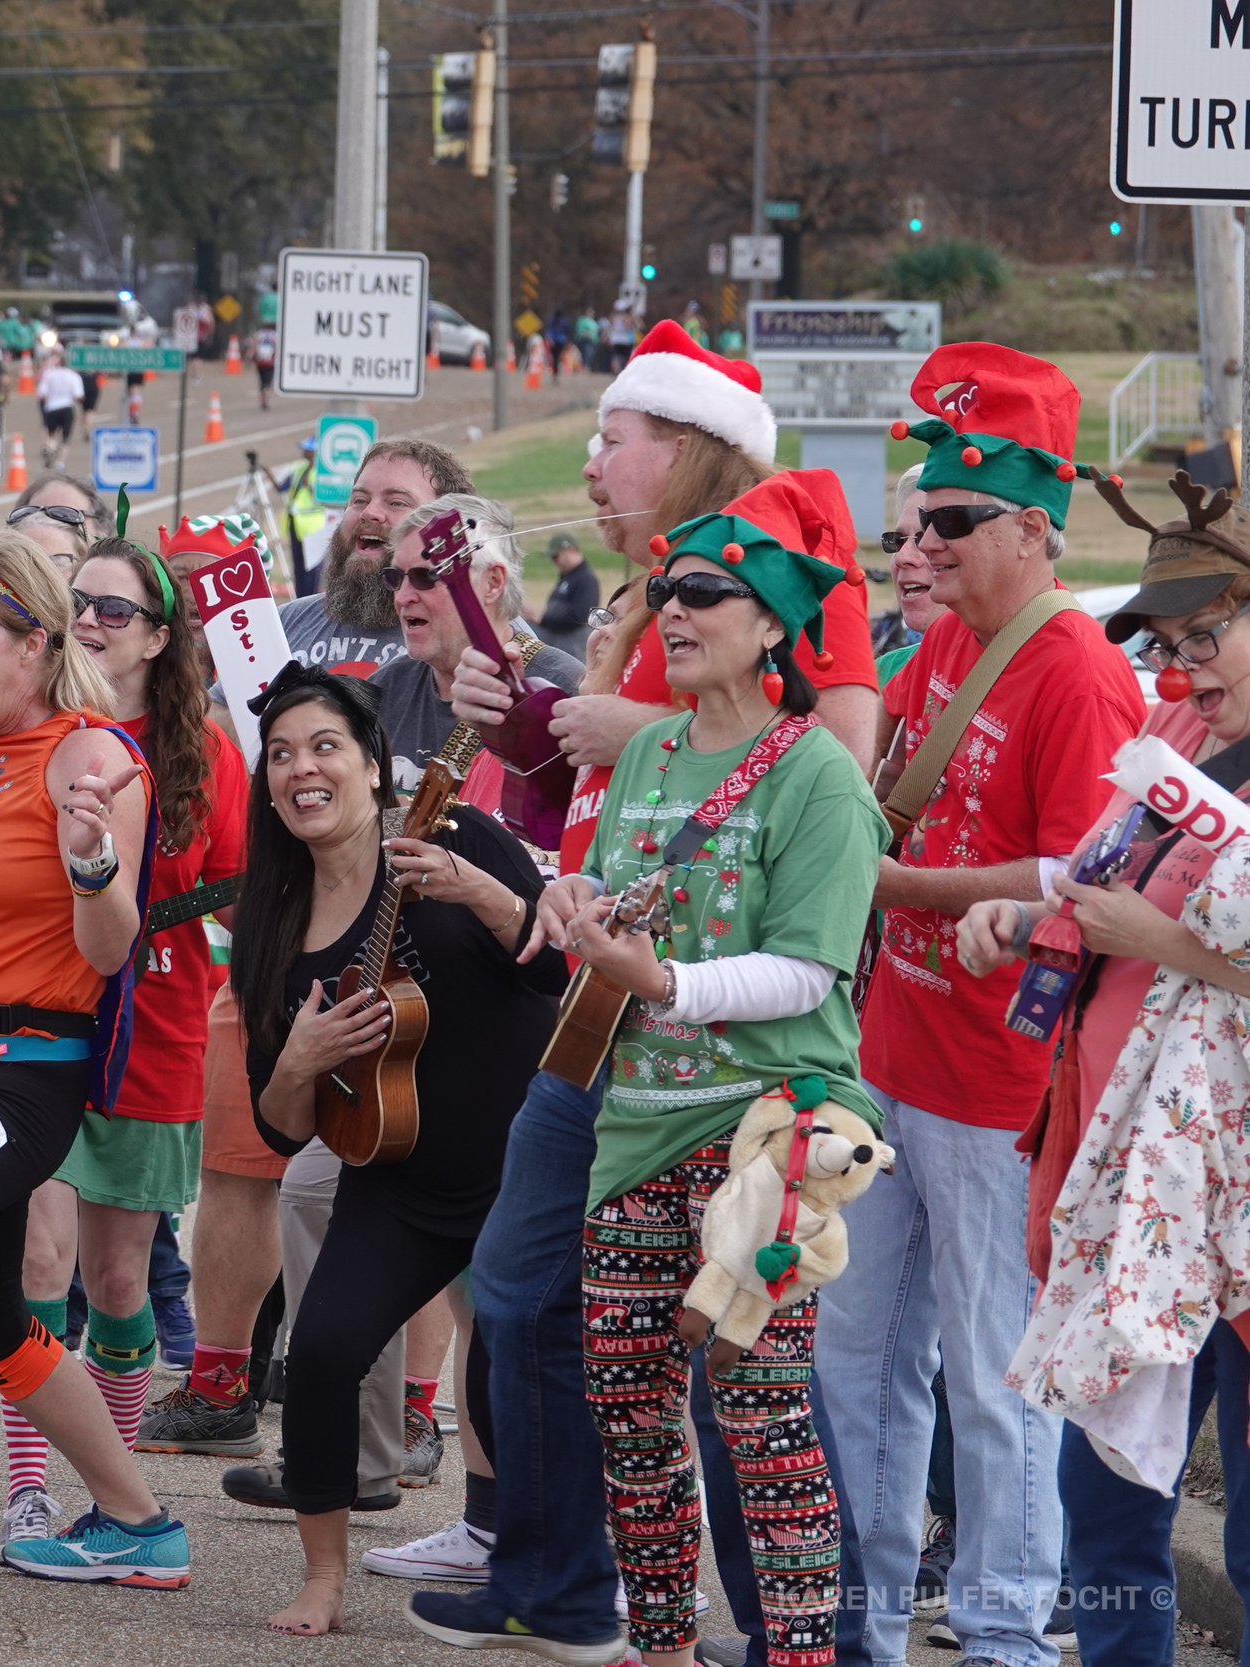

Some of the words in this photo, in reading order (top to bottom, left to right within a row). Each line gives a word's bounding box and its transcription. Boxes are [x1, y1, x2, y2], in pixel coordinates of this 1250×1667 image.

[1140, 96, 1250, 150] TUR
[291, 270, 353, 292] RIGHT
[359, 273, 414, 296] LANE
[315, 311, 390, 338] MUST
[85, 351, 165, 366] MANASSAS
[288, 353, 341, 376] TURN
[352, 356, 413, 380] RIGHT
[199, 573, 222, 607] I
[291, 636, 378, 670] DON'T
[596, 1228, 688, 1247] #SLEIGH
